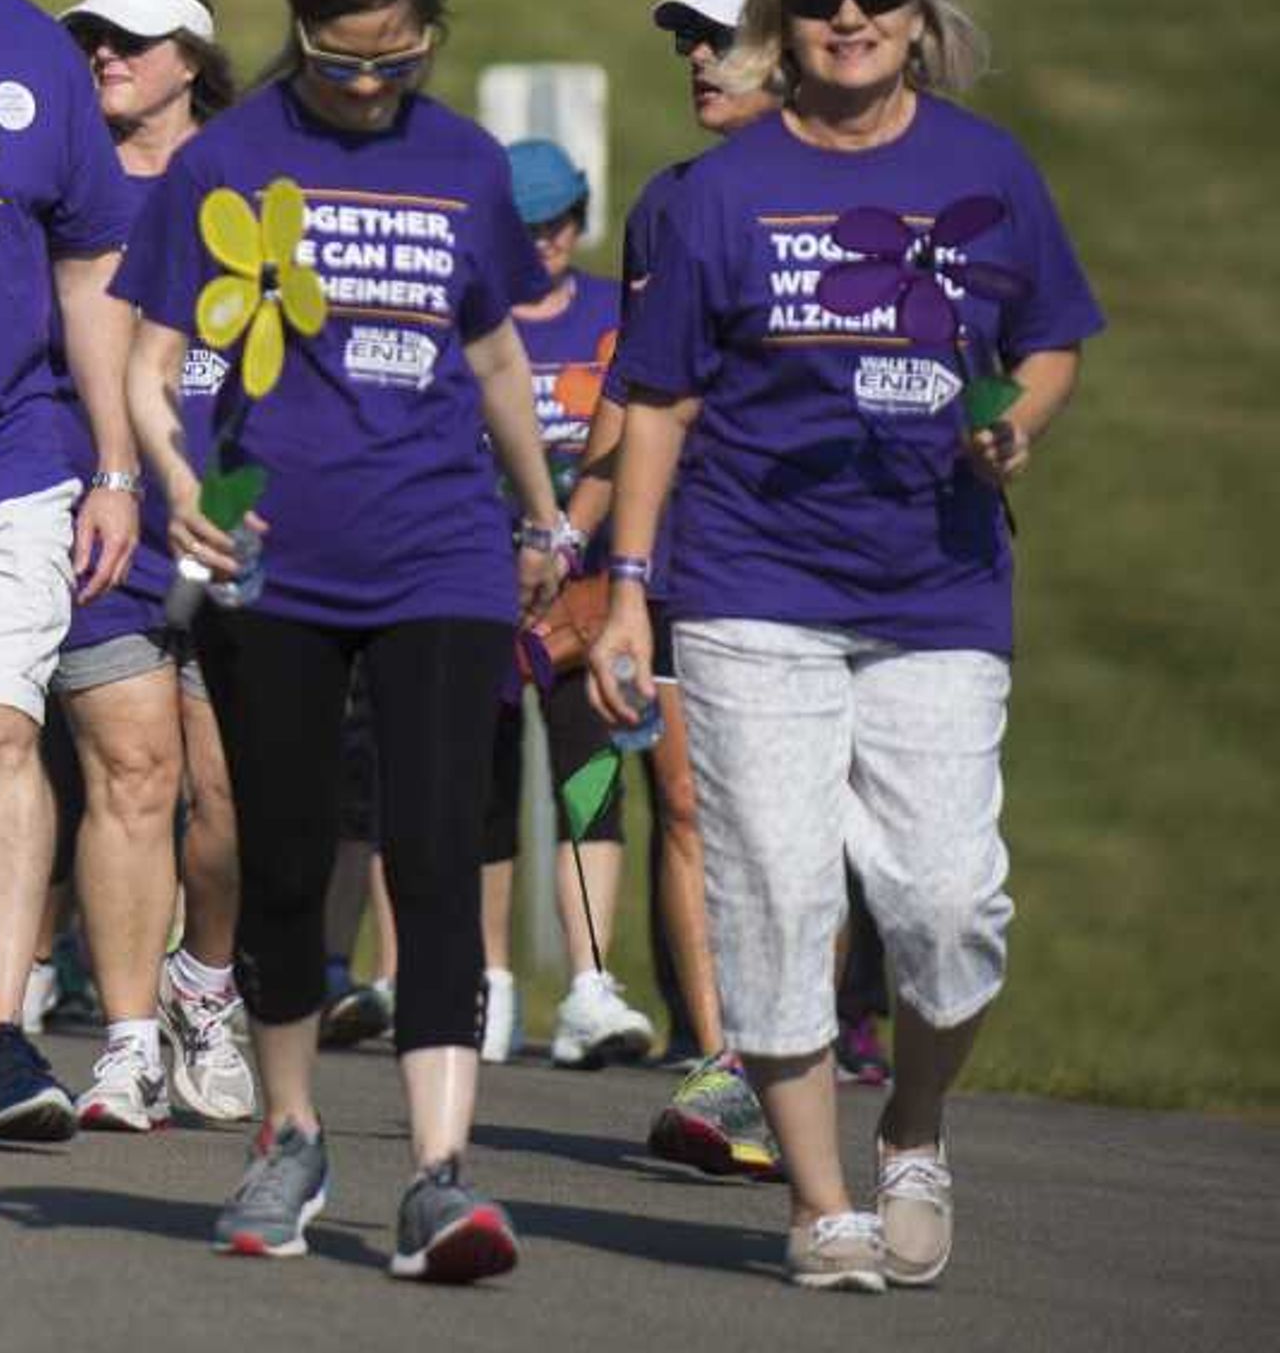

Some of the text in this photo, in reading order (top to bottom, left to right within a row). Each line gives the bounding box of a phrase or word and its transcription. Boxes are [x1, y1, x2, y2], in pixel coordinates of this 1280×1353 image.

[303, 205, 455, 246] GETHER,
[295, 240, 453, 277] E CAN END
[770, 304, 897, 332] ALZHEIM
[860, 356, 932, 372] WALK TO
[861, 373, 928, 390] END
